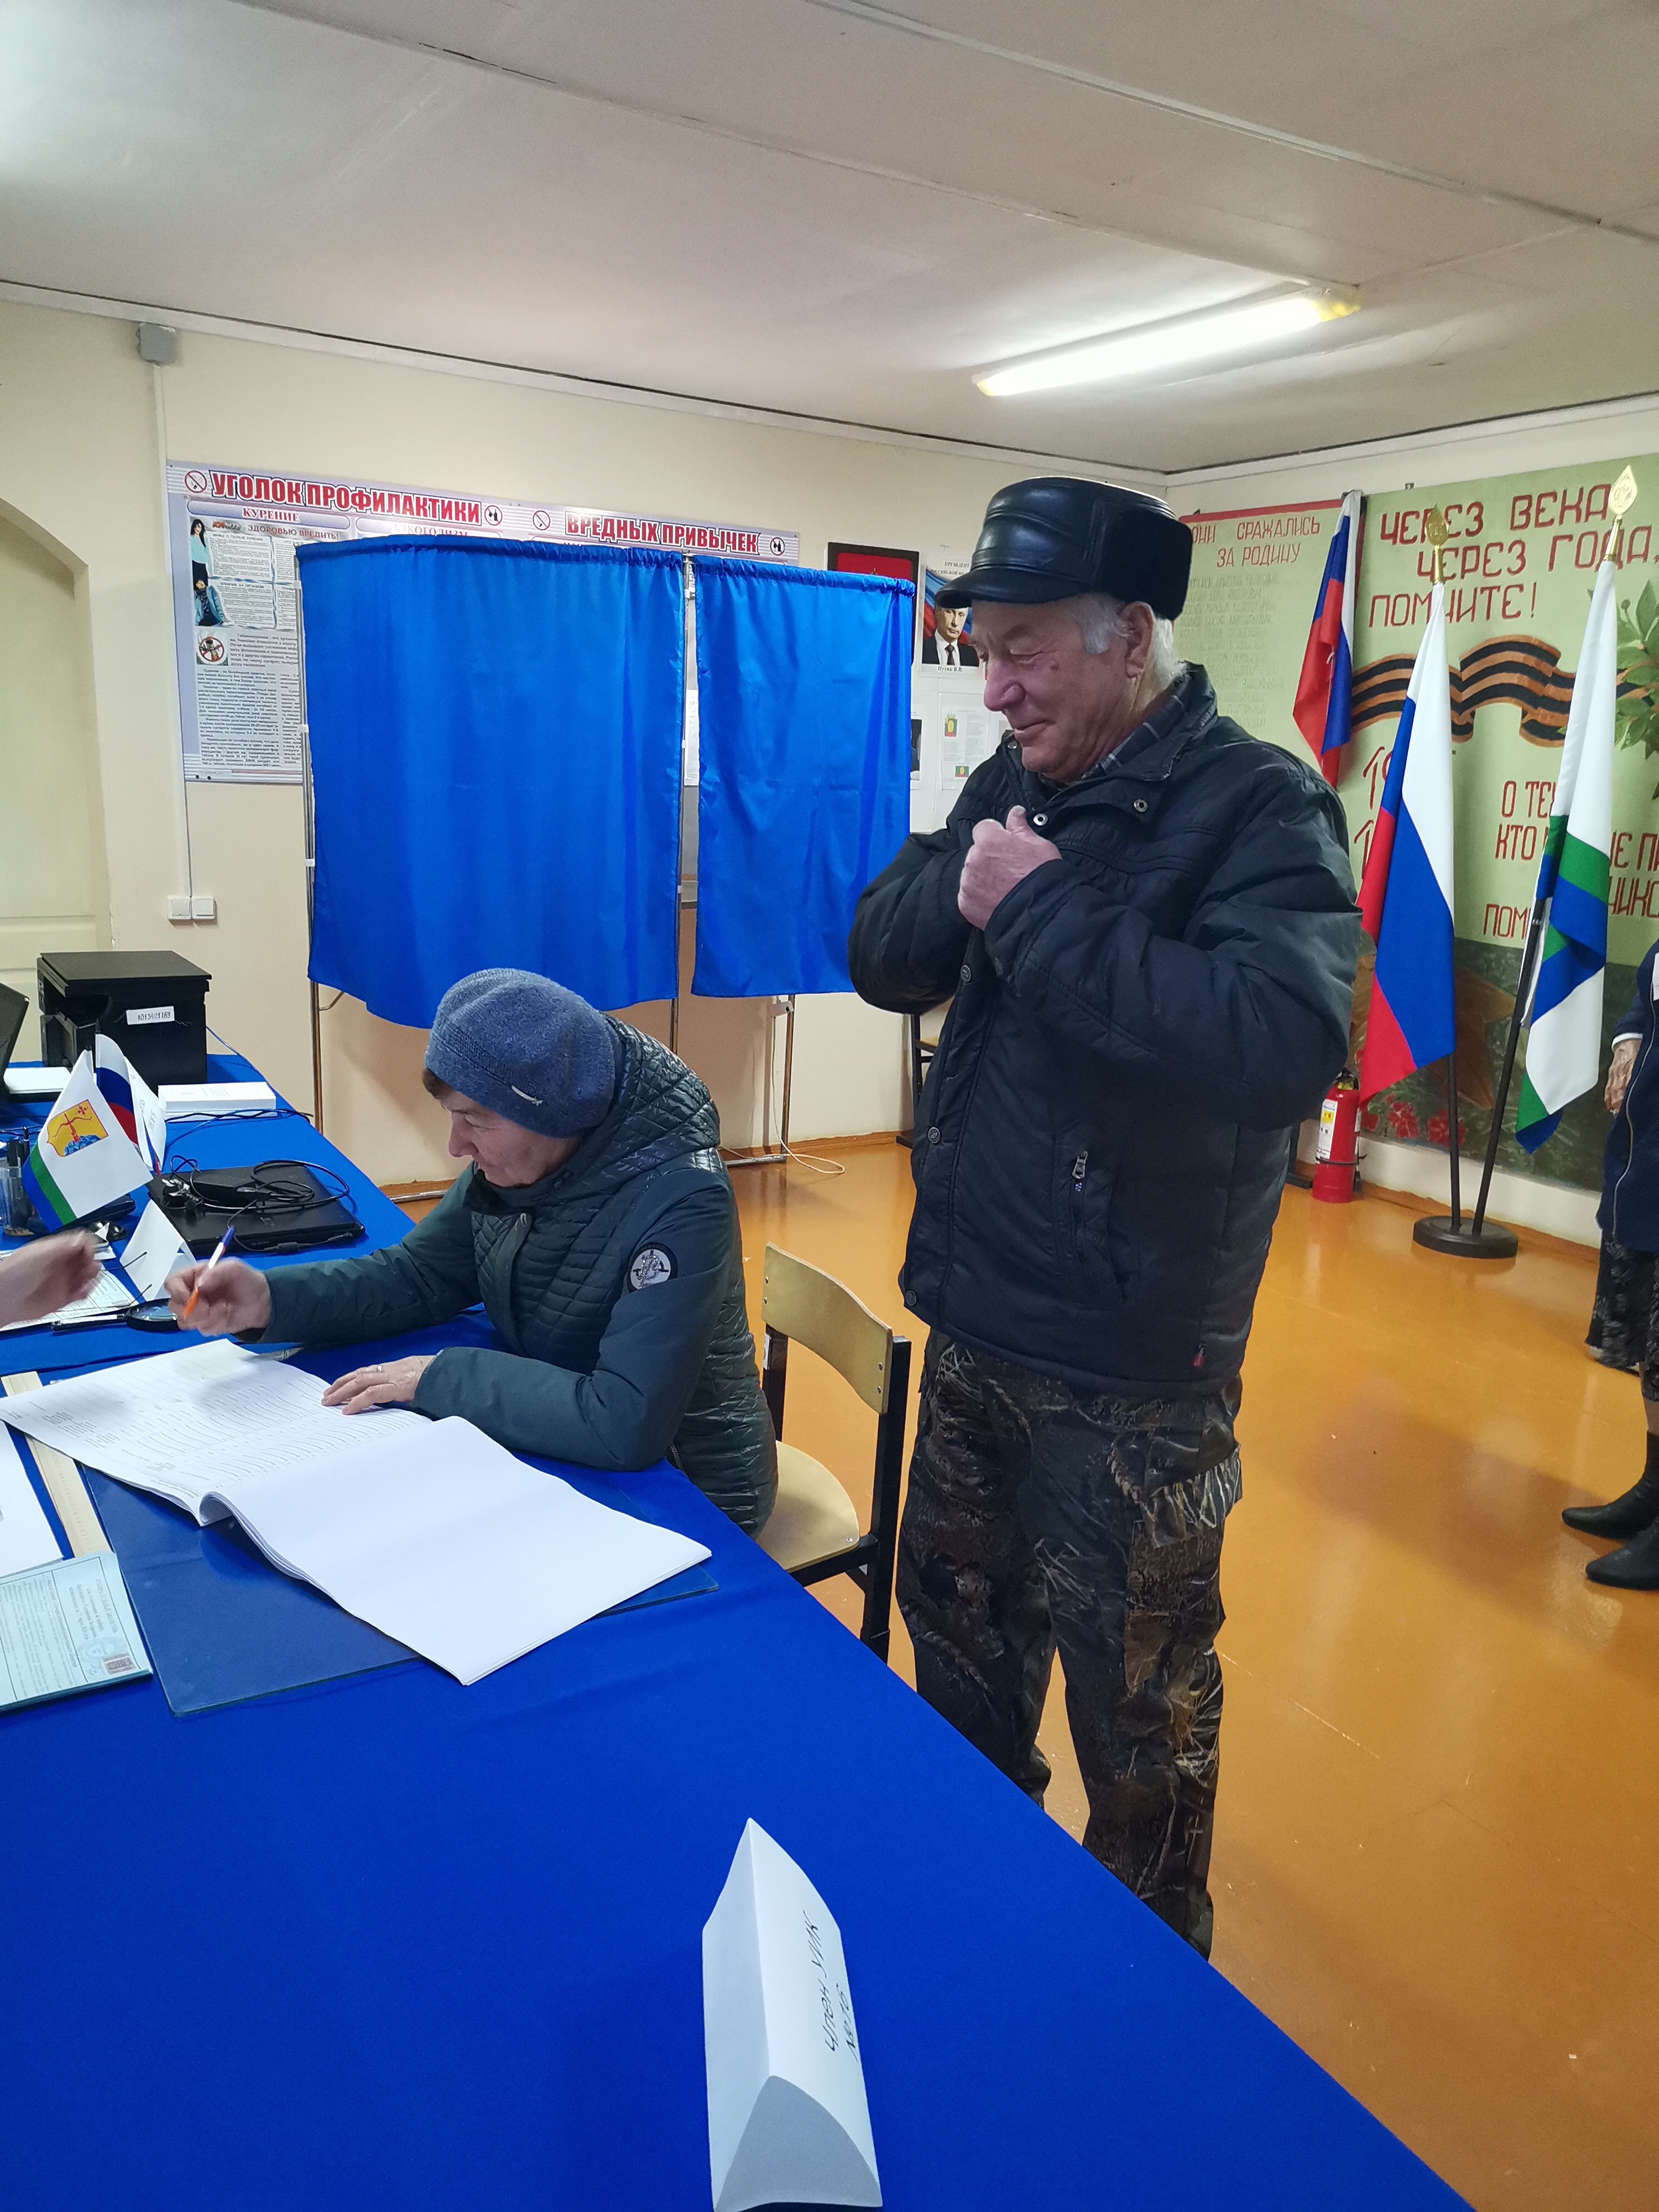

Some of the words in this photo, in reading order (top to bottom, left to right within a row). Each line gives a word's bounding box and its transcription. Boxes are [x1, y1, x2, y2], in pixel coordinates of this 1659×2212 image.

[212, 473, 304, 504] УГОЛОК
[307, 484, 479, 524] ПРОФИЛАКТИКИ
[242, 507, 299, 523] КУРЕНИЕ
[248, 524, 297, 536] ЗДОРОВЬЮ
[299, 530, 340, 540] ВРЕДИТЬ!
[567, 513, 659, 542] ВРЕДНЫХ
[662, 522, 757, 553] ПРИВЫЧЕК
[1237, 515, 1321, 541] СРАЖАЛИСЬ
[1217, 546, 1234, 568] ЗА
[1241, 542, 1301, 567] РОДИНУ
[1501, 780, 1517, 818] О
[1495, 822, 1537, 861] КТО
[1483, 903, 1530, 940] ПОМ
